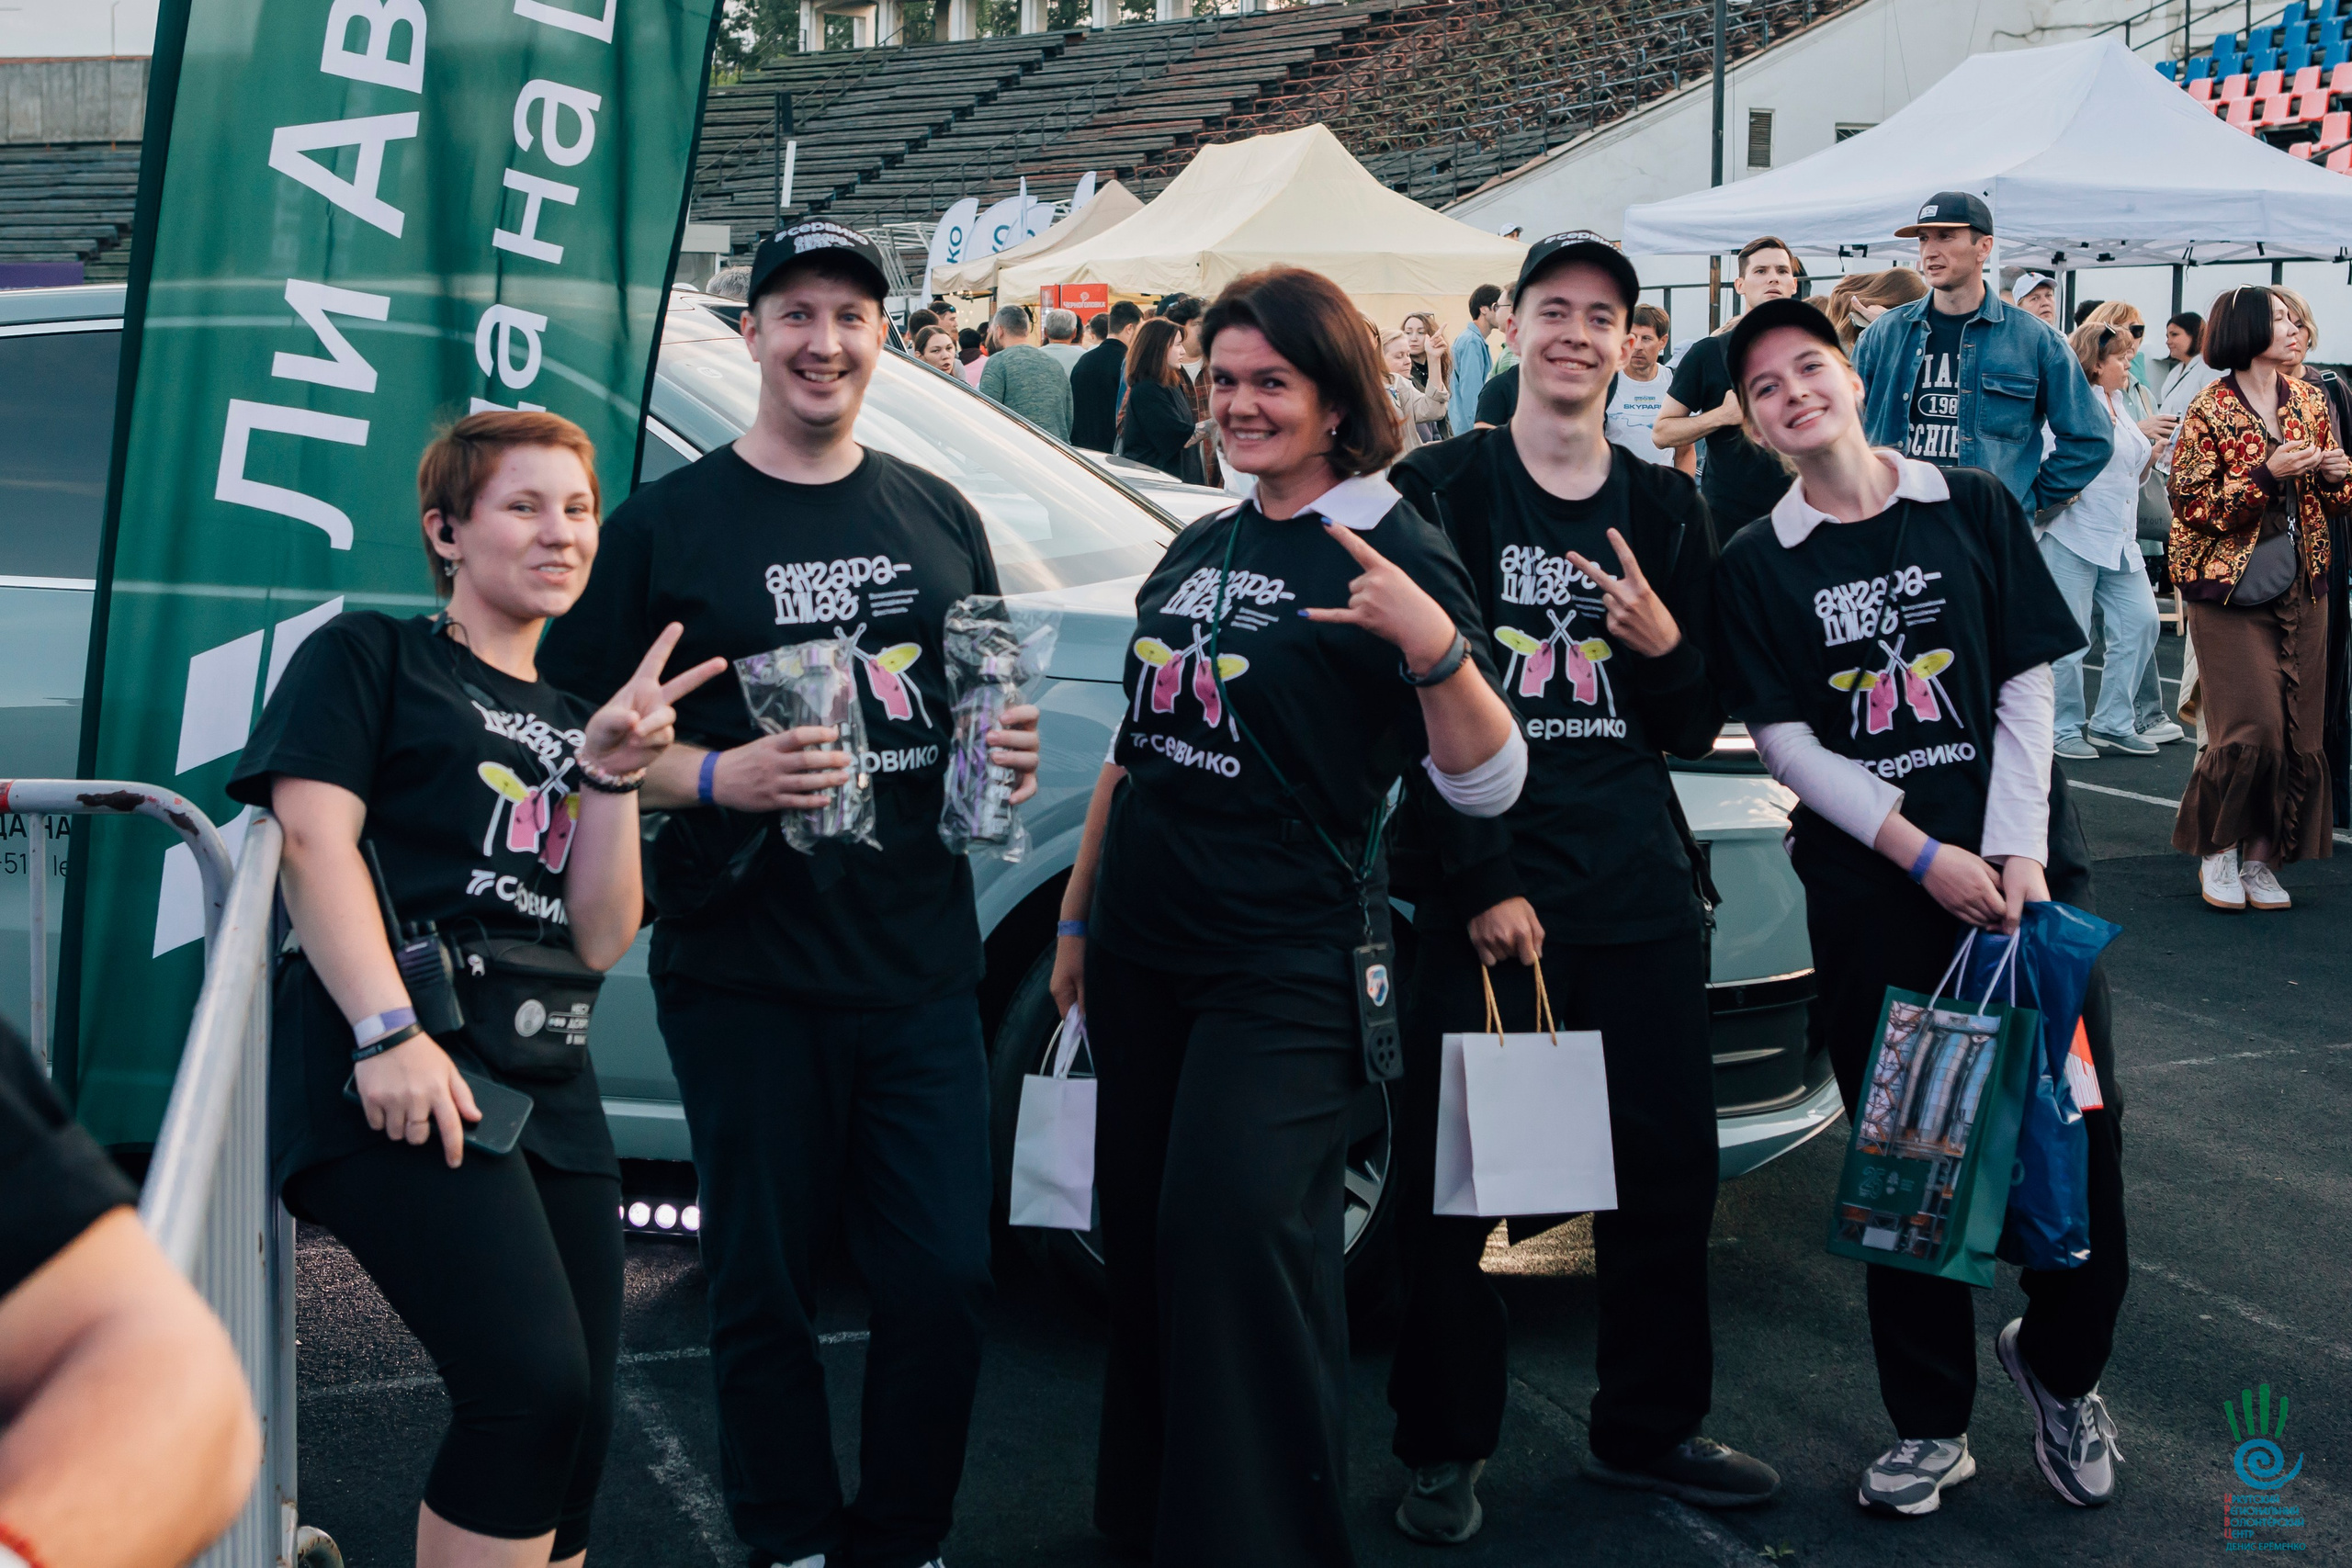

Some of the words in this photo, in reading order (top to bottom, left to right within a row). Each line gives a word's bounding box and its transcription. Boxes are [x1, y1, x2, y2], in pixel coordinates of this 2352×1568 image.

[492, 79, 602, 265] на
[765, 555, 912, 595] ангара-
[775, 588, 860, 625] джаз
